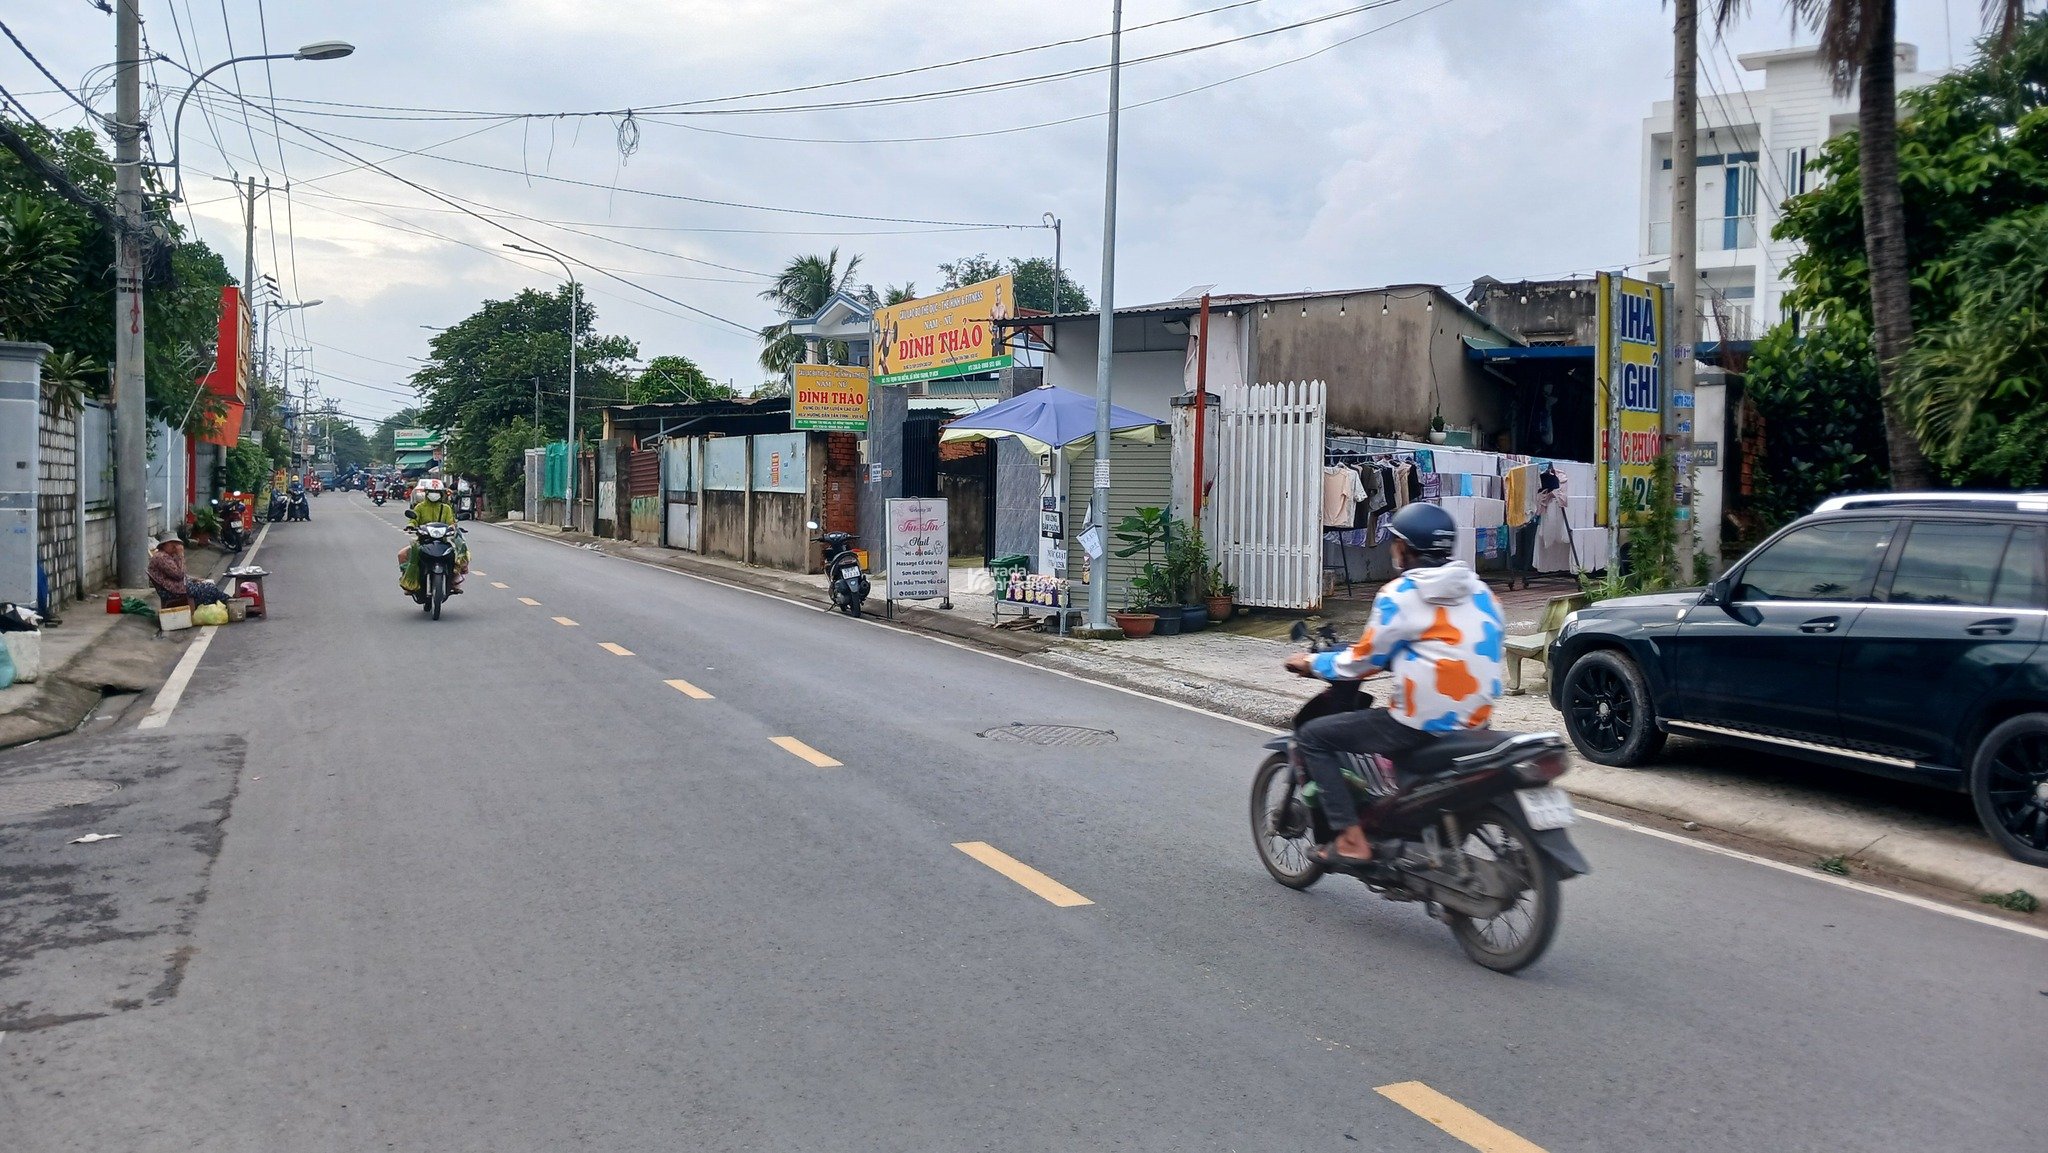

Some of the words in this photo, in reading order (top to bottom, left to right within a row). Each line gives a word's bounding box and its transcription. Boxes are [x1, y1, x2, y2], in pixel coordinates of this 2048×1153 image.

[899, 333, 935, 361] ĐÌNH
[938, 317, 983, 354] THẢO
[798, 387, 829, 404] ĐÌNH
[831, 387, 864, 405] THẢO
[1621, 352, 1659, 411] GHỈ
[909, 536, 930, 546] Nail
